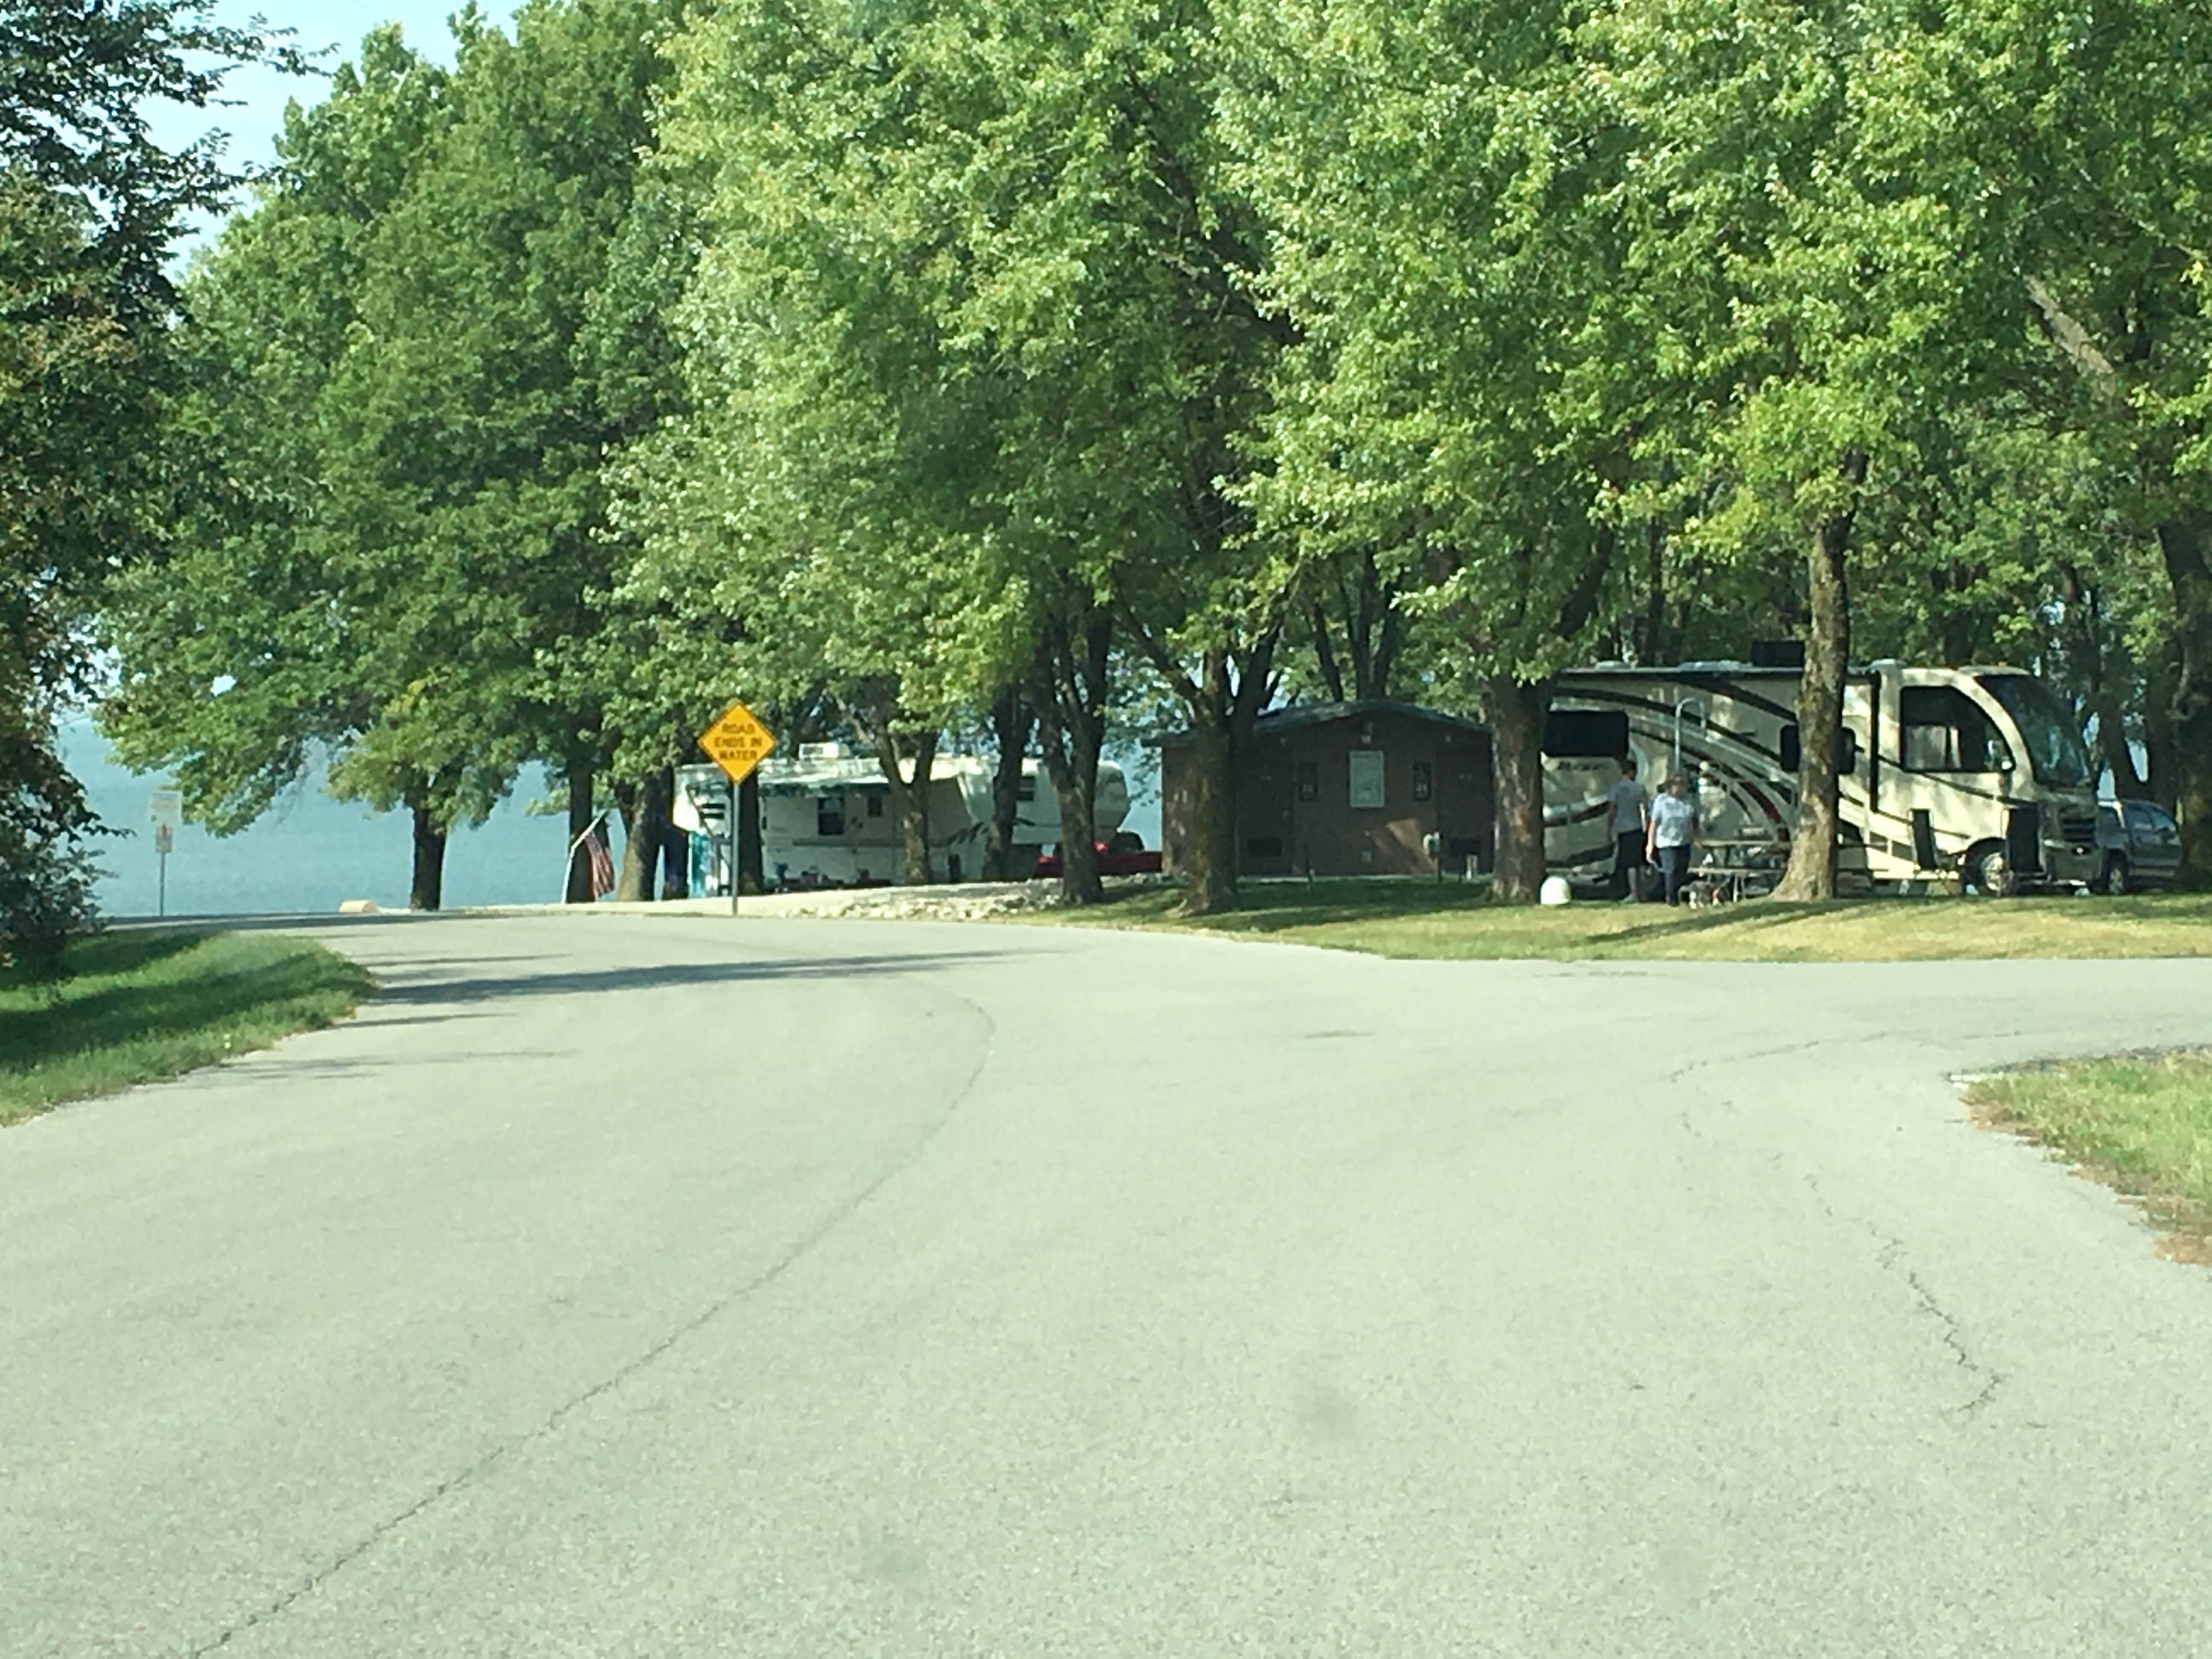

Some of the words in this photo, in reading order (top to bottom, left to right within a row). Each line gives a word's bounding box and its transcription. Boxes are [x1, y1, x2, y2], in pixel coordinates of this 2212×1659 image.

[722, 723, 755, 734] ROAD
[714, 737, 745, 748] ENDS
[751, 737, 762, 747] IN
[719, 750, 758, 761] WATER
